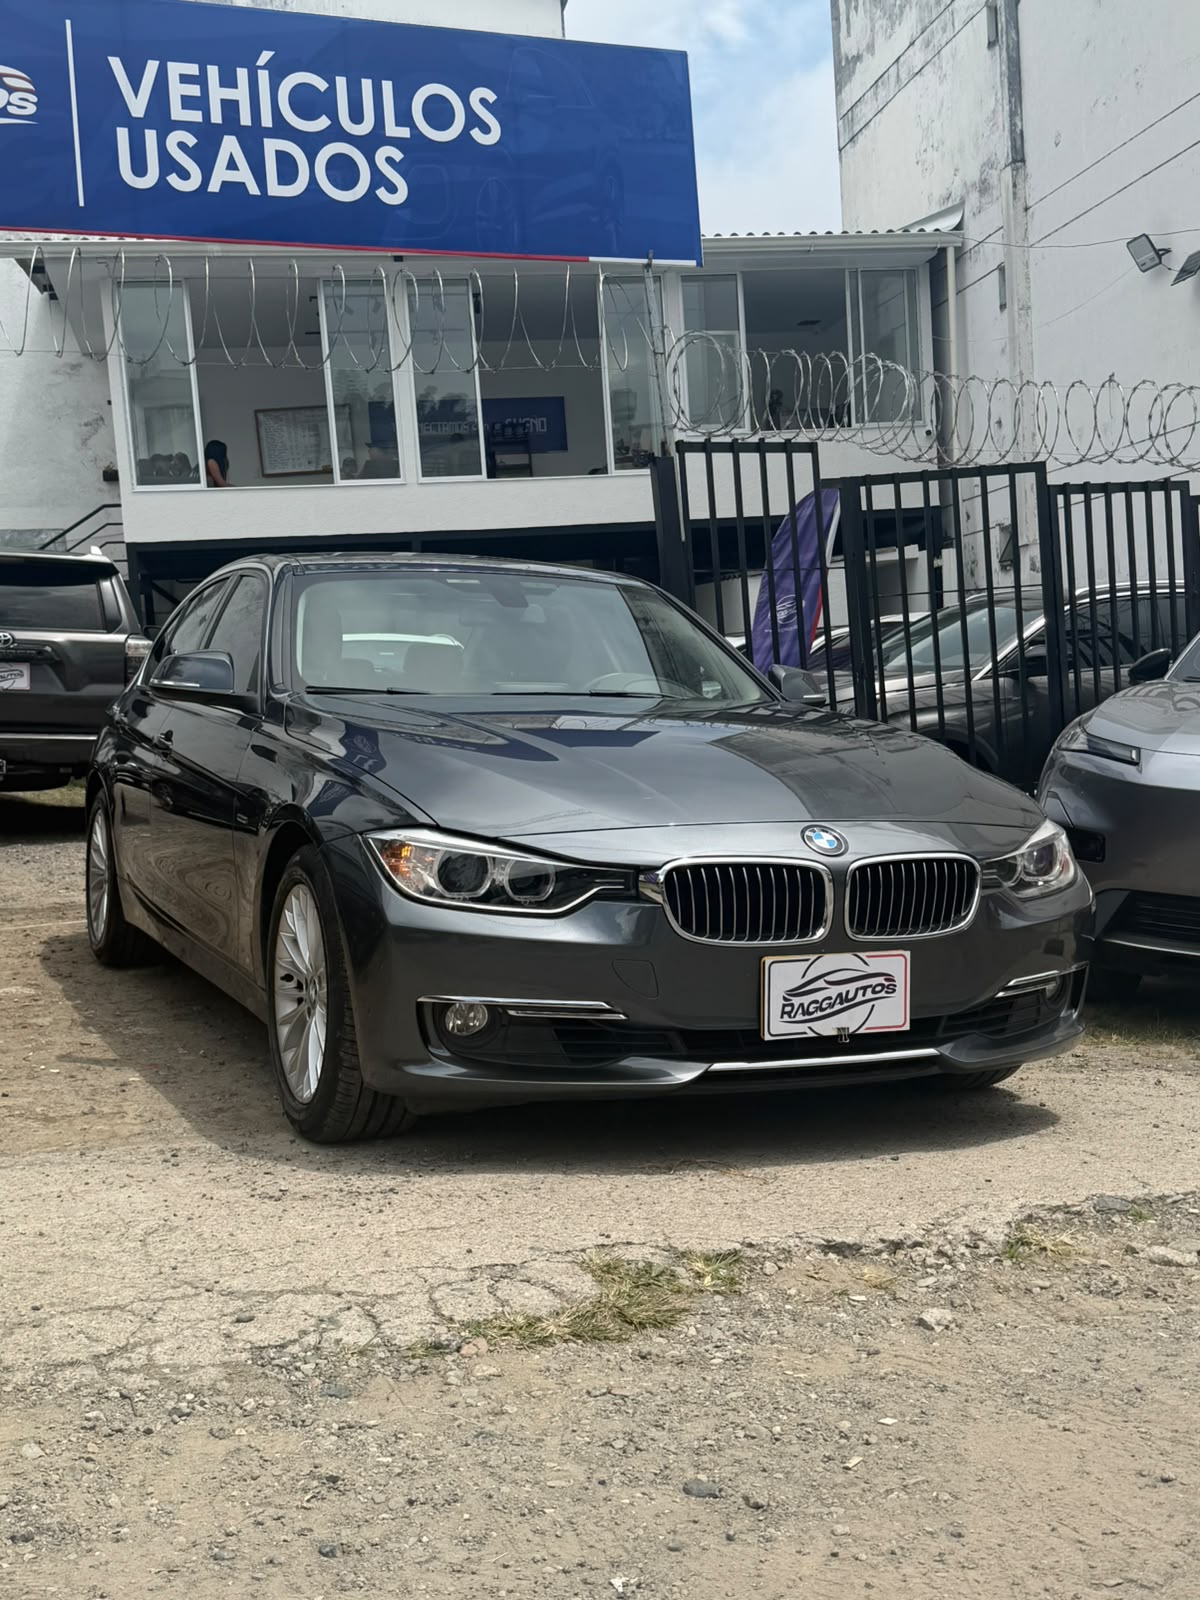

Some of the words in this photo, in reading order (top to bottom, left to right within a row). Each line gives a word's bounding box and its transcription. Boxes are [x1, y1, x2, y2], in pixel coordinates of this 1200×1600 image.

[107, 50, 502, 146] VEHÍCULOS
[116, 127, 409, 206] USADOS
[780, 981, 898, 1020] RAGGAUTOS
